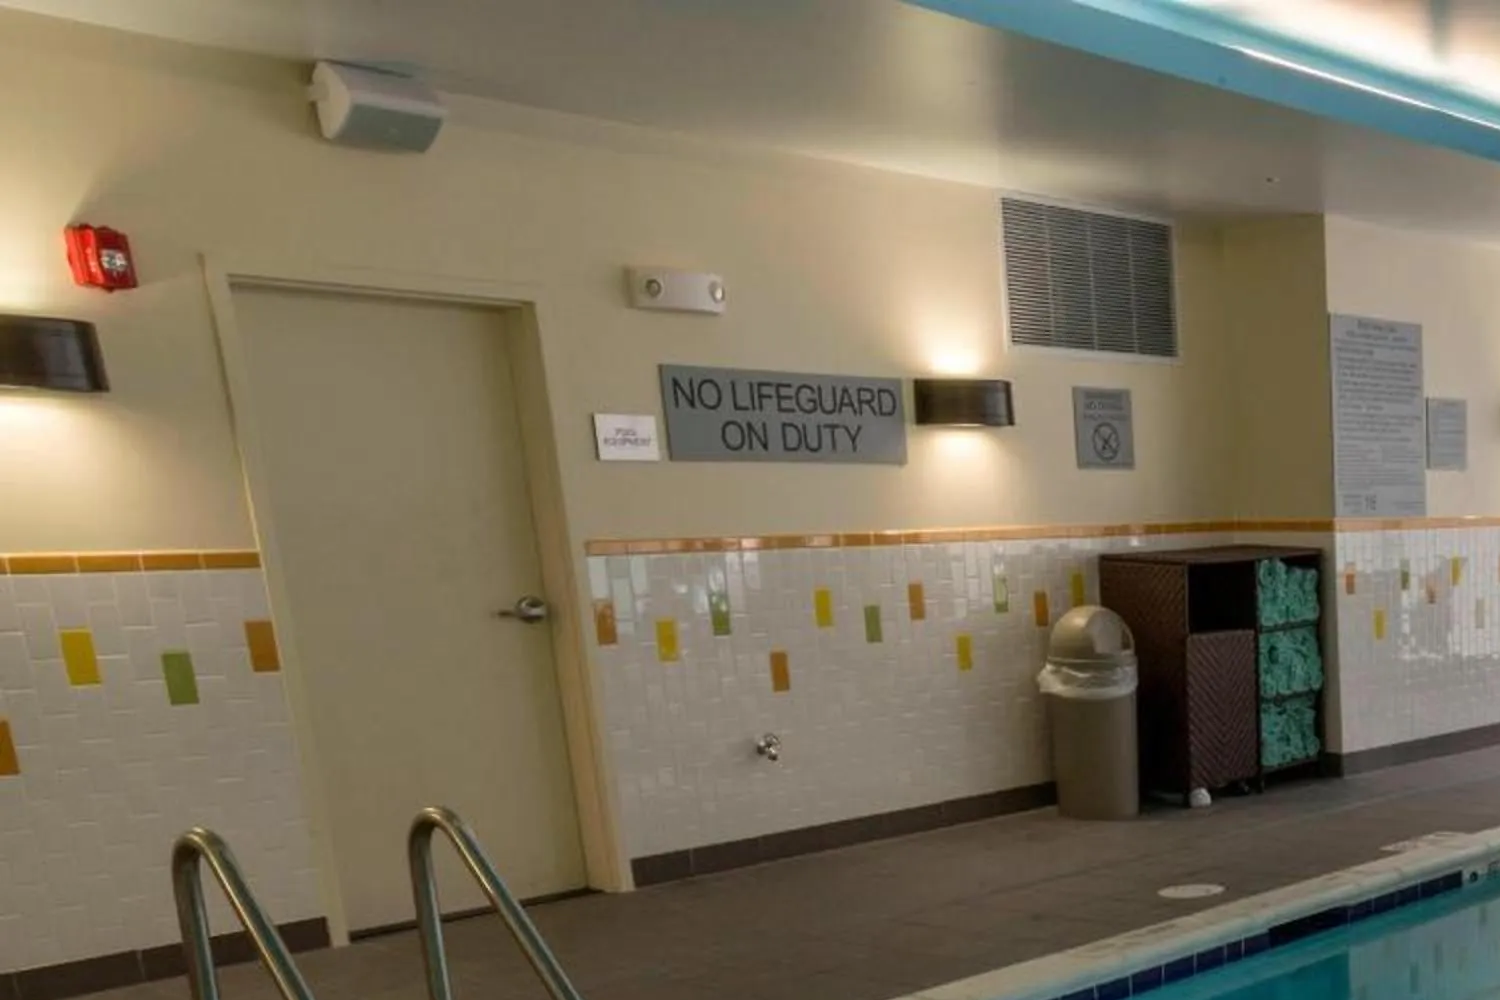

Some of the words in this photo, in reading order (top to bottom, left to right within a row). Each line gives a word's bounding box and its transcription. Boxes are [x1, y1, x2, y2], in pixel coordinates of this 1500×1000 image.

[671, 377, 723, 411] NO
[729, 381, 897, 417] LIFEGUARD
[721, 420, 768, 452] ON
[782, 422, 864, 453] DUTY
